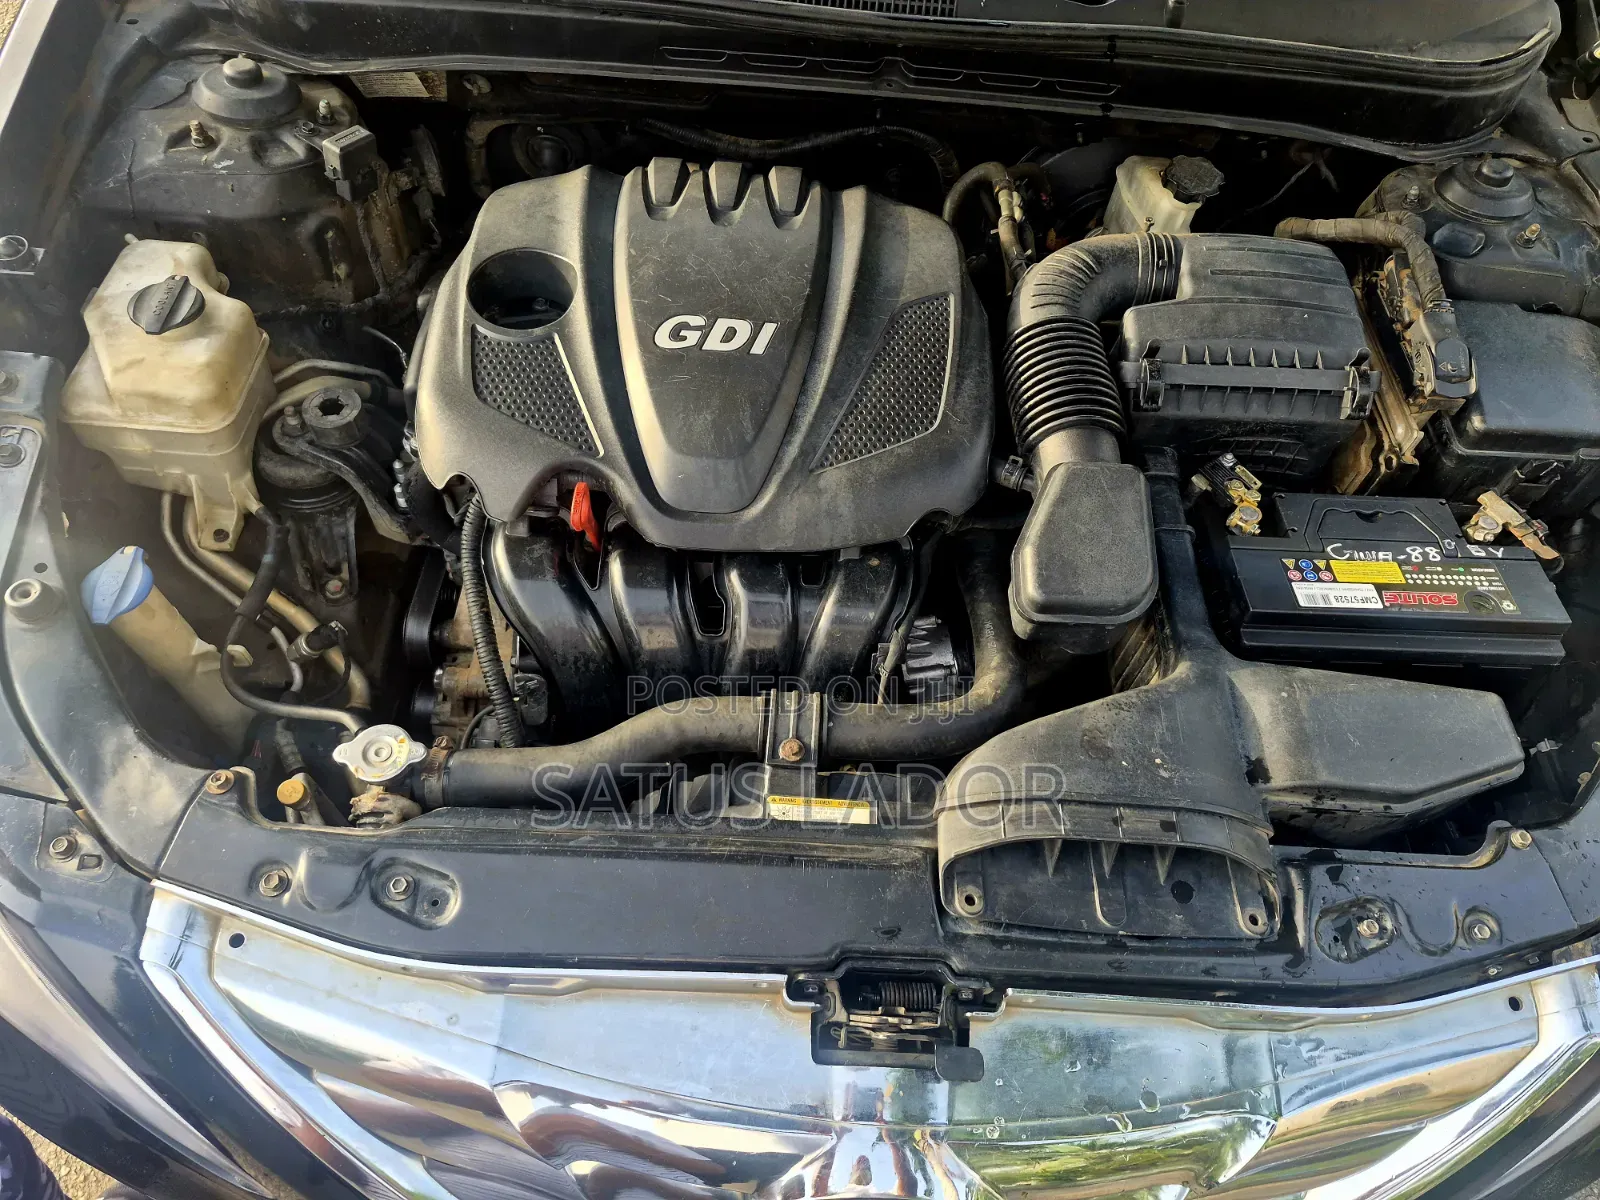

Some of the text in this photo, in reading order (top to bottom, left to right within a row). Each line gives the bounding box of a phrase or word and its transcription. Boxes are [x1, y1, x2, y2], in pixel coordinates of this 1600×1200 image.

[654, 314, 780, 356] GDI
[1334, 595, 1379, 604] CMF57528
[1382, 590, 1459, 606] SOLITE
